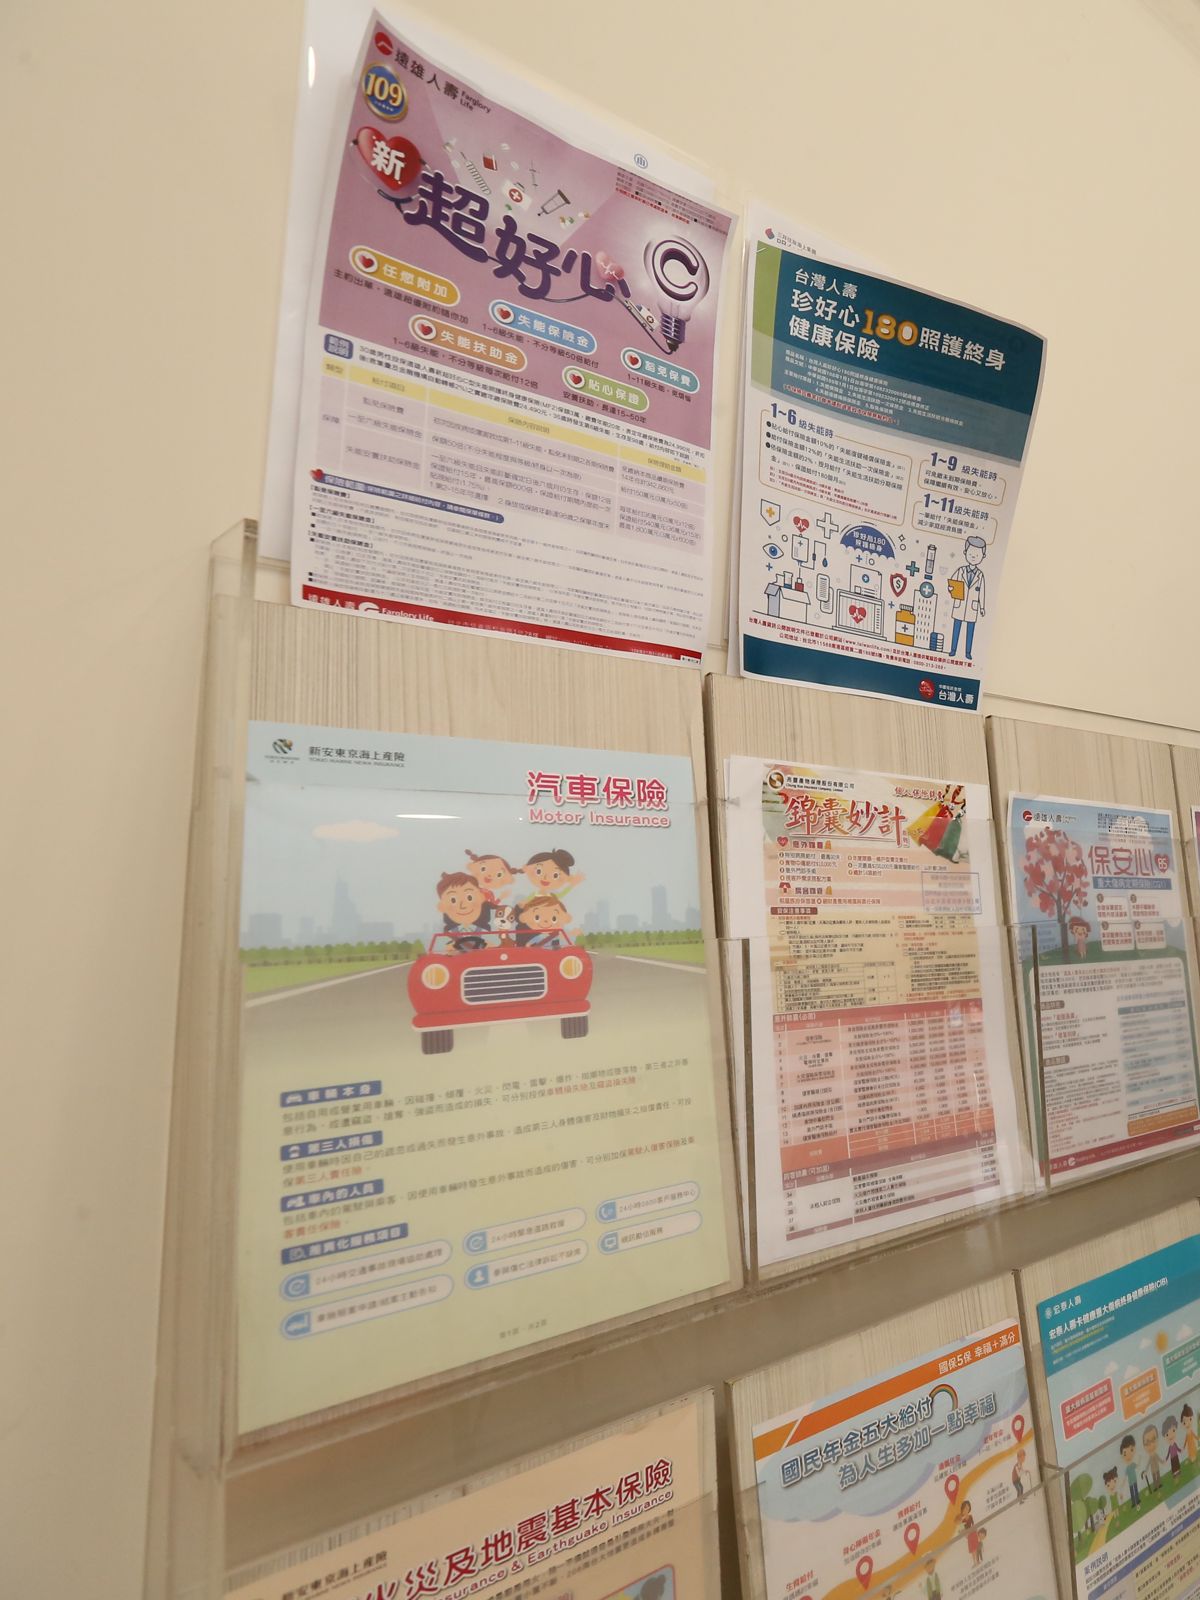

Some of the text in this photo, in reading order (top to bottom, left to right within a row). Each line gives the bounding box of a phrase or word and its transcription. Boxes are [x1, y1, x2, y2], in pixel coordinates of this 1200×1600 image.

[366, 72, 403, 107] 109
[394, 48, 459, 100] 遠雄人壽
[460, 90, 491, 113] Farglory Life
[371, 135, 405, 185] 新
[404, 171, 632, 302] 超好心
[795, 267, 858, 300] 台灣人壽
[517, 314, 590, 349] 失能保險金
[788, 314, 880, 362] 健康保險
[790, 288, 1006, 371] 珍好心180照護終身
[440, 329, 519, 366] 失能扶助金
[644, 359, 692, 388] 豁免保費
[588, 378, 641, 406] 貼心保證
[771, 403, 797, 425] 1~6
[799, 419, 834, 438] 級失能時
[931, 452, 998, 481] 1~9 級失能時
[924, 493, 989, 521] 1~11 級失能時
[938, 691, 974, 705] 台灣人壽
[309, 746, 405, 762] 新安東京海上產險
[528, 771, 667, 809] 汽車保險
[529, 808, 670, 828] Motor Insurance
[784, 794, 907, 848] 錦囊妙計
[1088, 845, 1155, 876] 保安心
[1052, 1295, 1082, 1315] 宏泰人壽
[938, 1350, 972, 1375] 國保5保
[781, 1394, 934, 1487] 國民年金五大給付
[838, 1392, 997, 1491] 為人生多加一點幸福
[511, 1560, 523, 1572] &
[611, 1491, 673, 1525] Insurance
